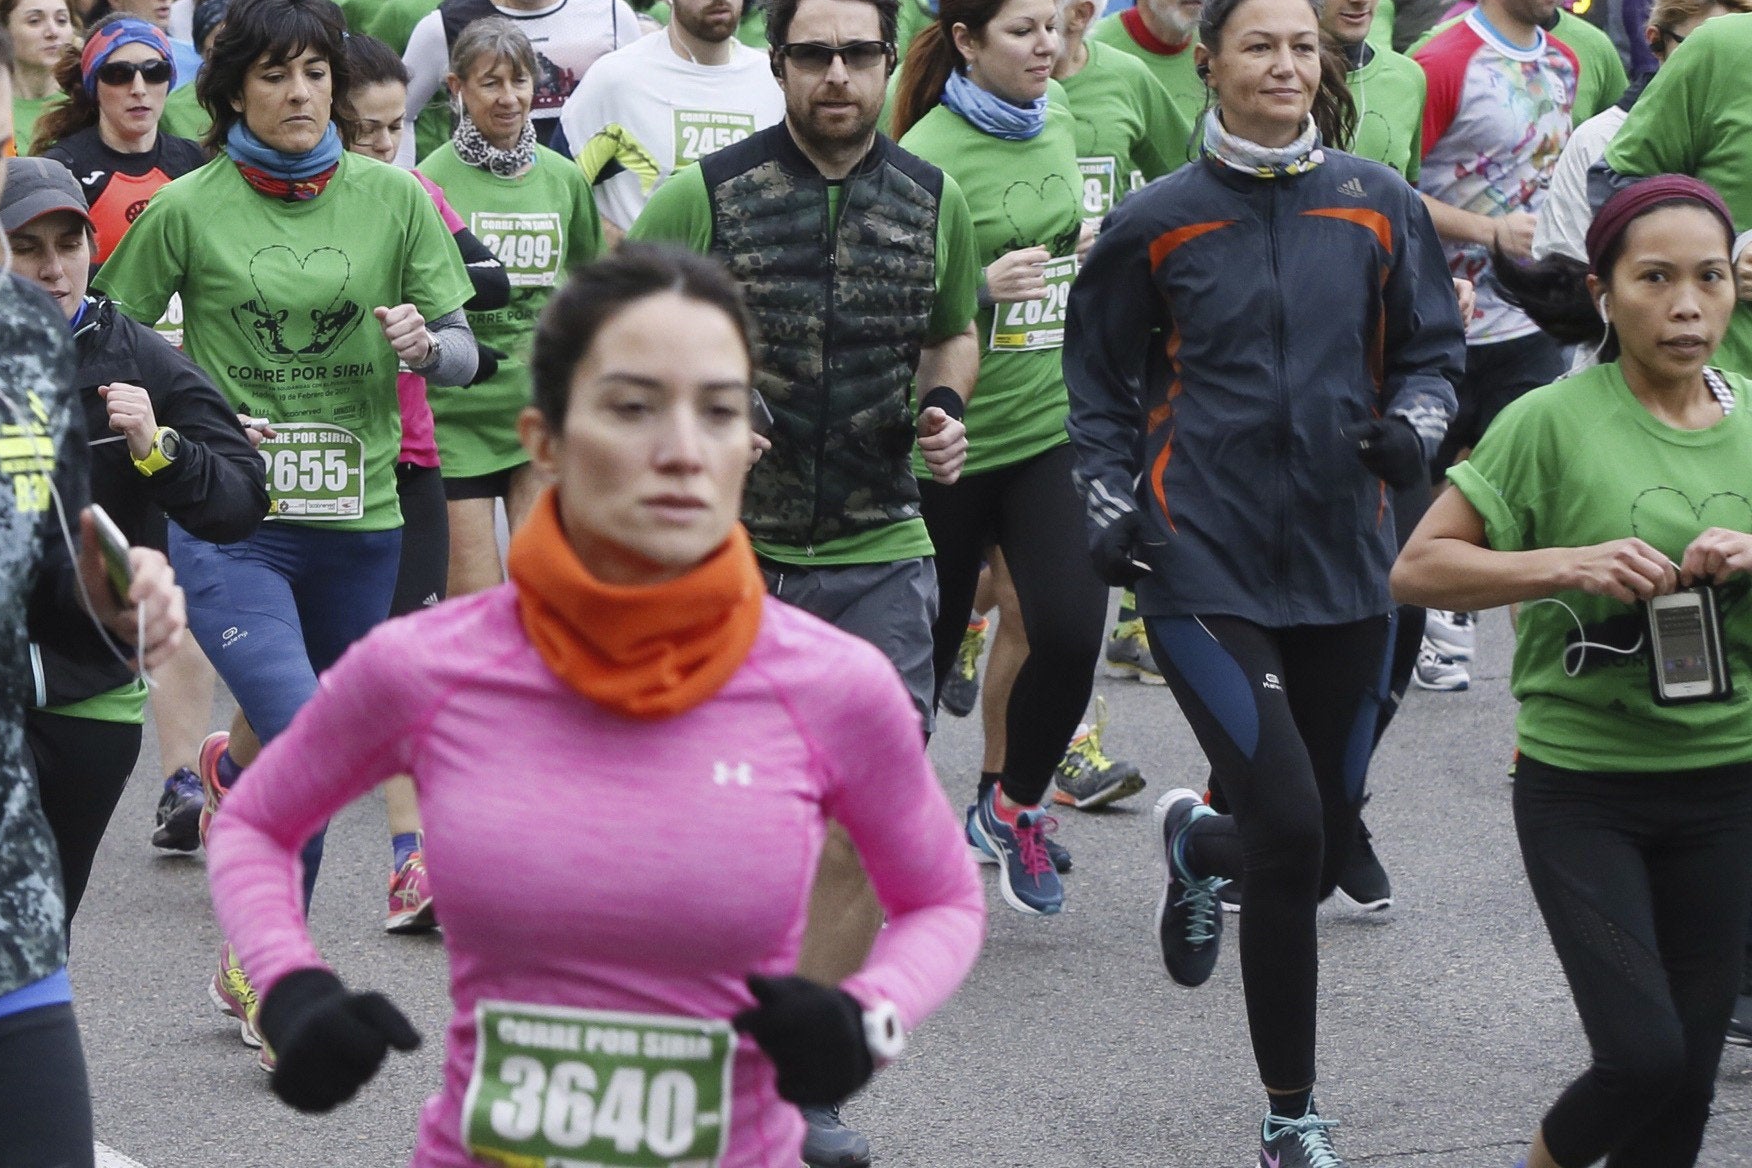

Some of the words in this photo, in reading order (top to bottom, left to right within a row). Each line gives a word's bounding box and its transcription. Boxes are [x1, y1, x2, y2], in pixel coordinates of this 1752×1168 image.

[482, 233, 552, 268] 2499
[467, 311, 503, 324] ORRE
[227, 365, 286, 383] CORRE
[291, 366, 328, 382] POR
[333, 361, 374, 379] SIRIA
[292, 431, 317, 444] POR
[319, 431, 353, 444] SIRIA
[586, 1025, 637, 1056] POR
[490, 1055, 699, 1158] 3640
